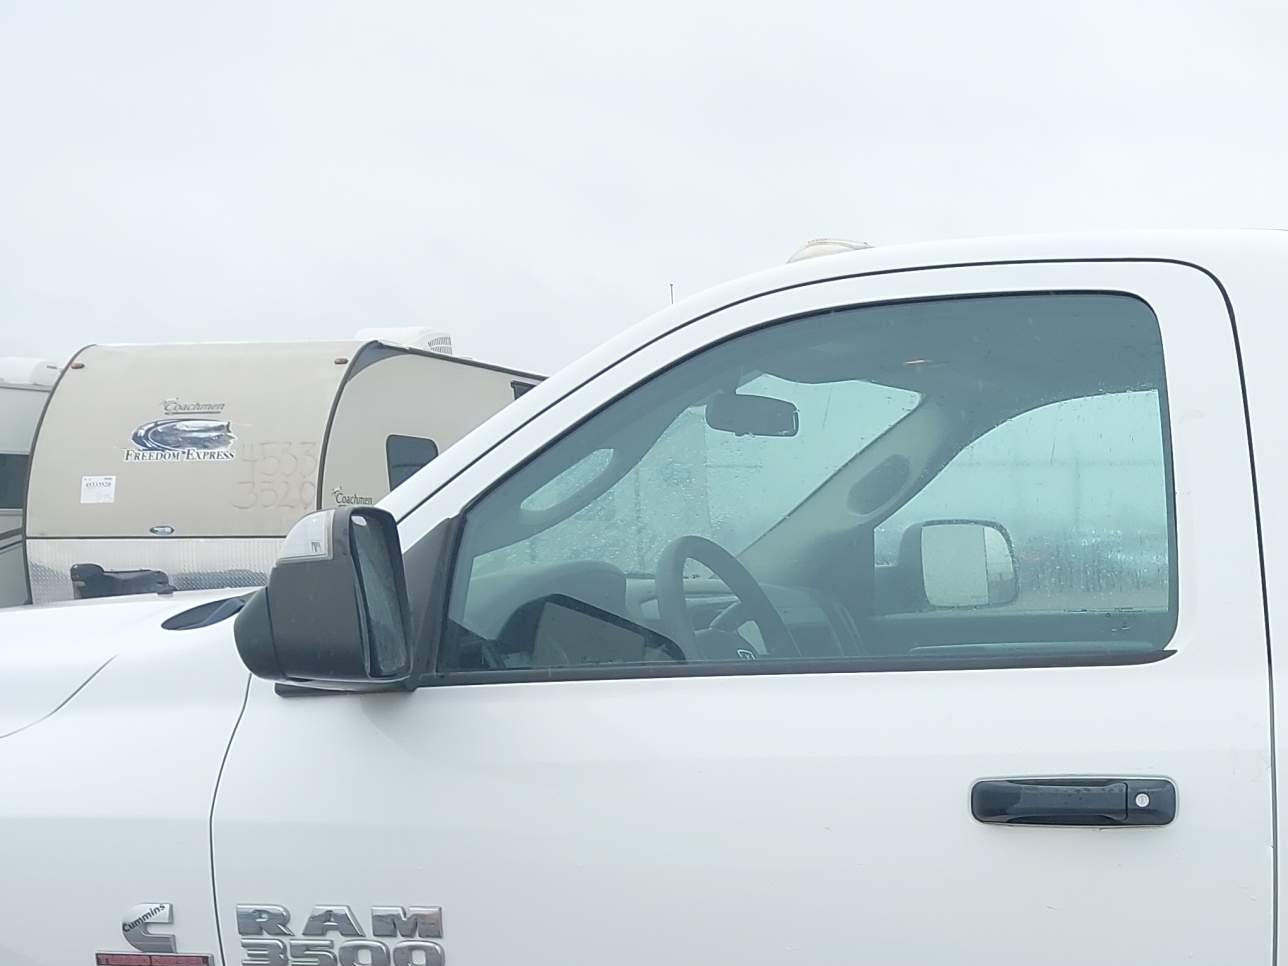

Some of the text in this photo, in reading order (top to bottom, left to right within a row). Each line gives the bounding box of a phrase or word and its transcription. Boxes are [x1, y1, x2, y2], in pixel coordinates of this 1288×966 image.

[125, 448, 235, 461] FREEDOM EXPRESS
[122, 904, 166, 933] Cummins
[236, 903, 443, 939] RAM
